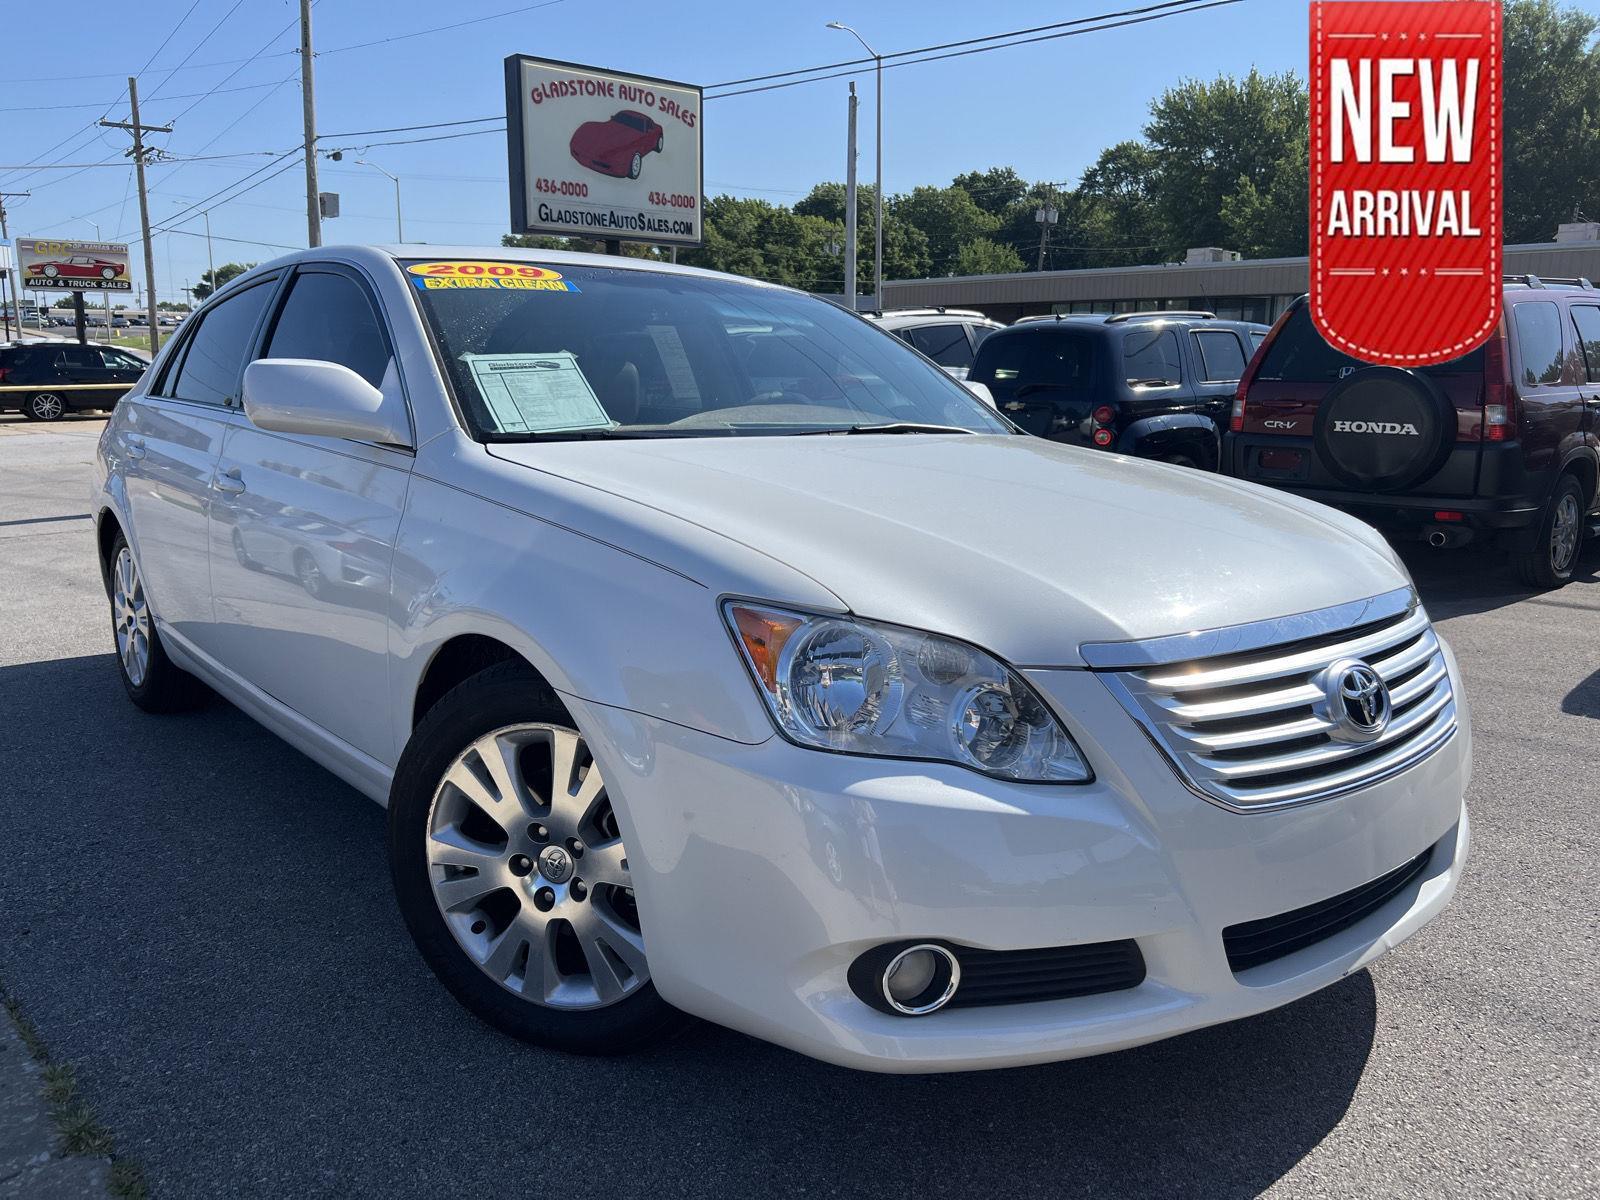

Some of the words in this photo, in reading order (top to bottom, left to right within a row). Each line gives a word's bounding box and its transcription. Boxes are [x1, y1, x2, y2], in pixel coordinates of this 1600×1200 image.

[531, 79, 614, 105] GLADSTONE
[619, 84, 655, 107] AUTO
[658, 96, 697, 128] SALES
[535, 178, 589, 198] 436-0000
[648, 191, 695, 209] 436-0000
[34, 242, 72, 257] GRC
[427, 265, 543, 278] 2009
[424, 278, 499, 289] EXTRA
[499, 280, 568, 292] CLEAN
[1263, 420, 1299, 429] CR-V
[1333, 420, 1419, 435] HONDA
